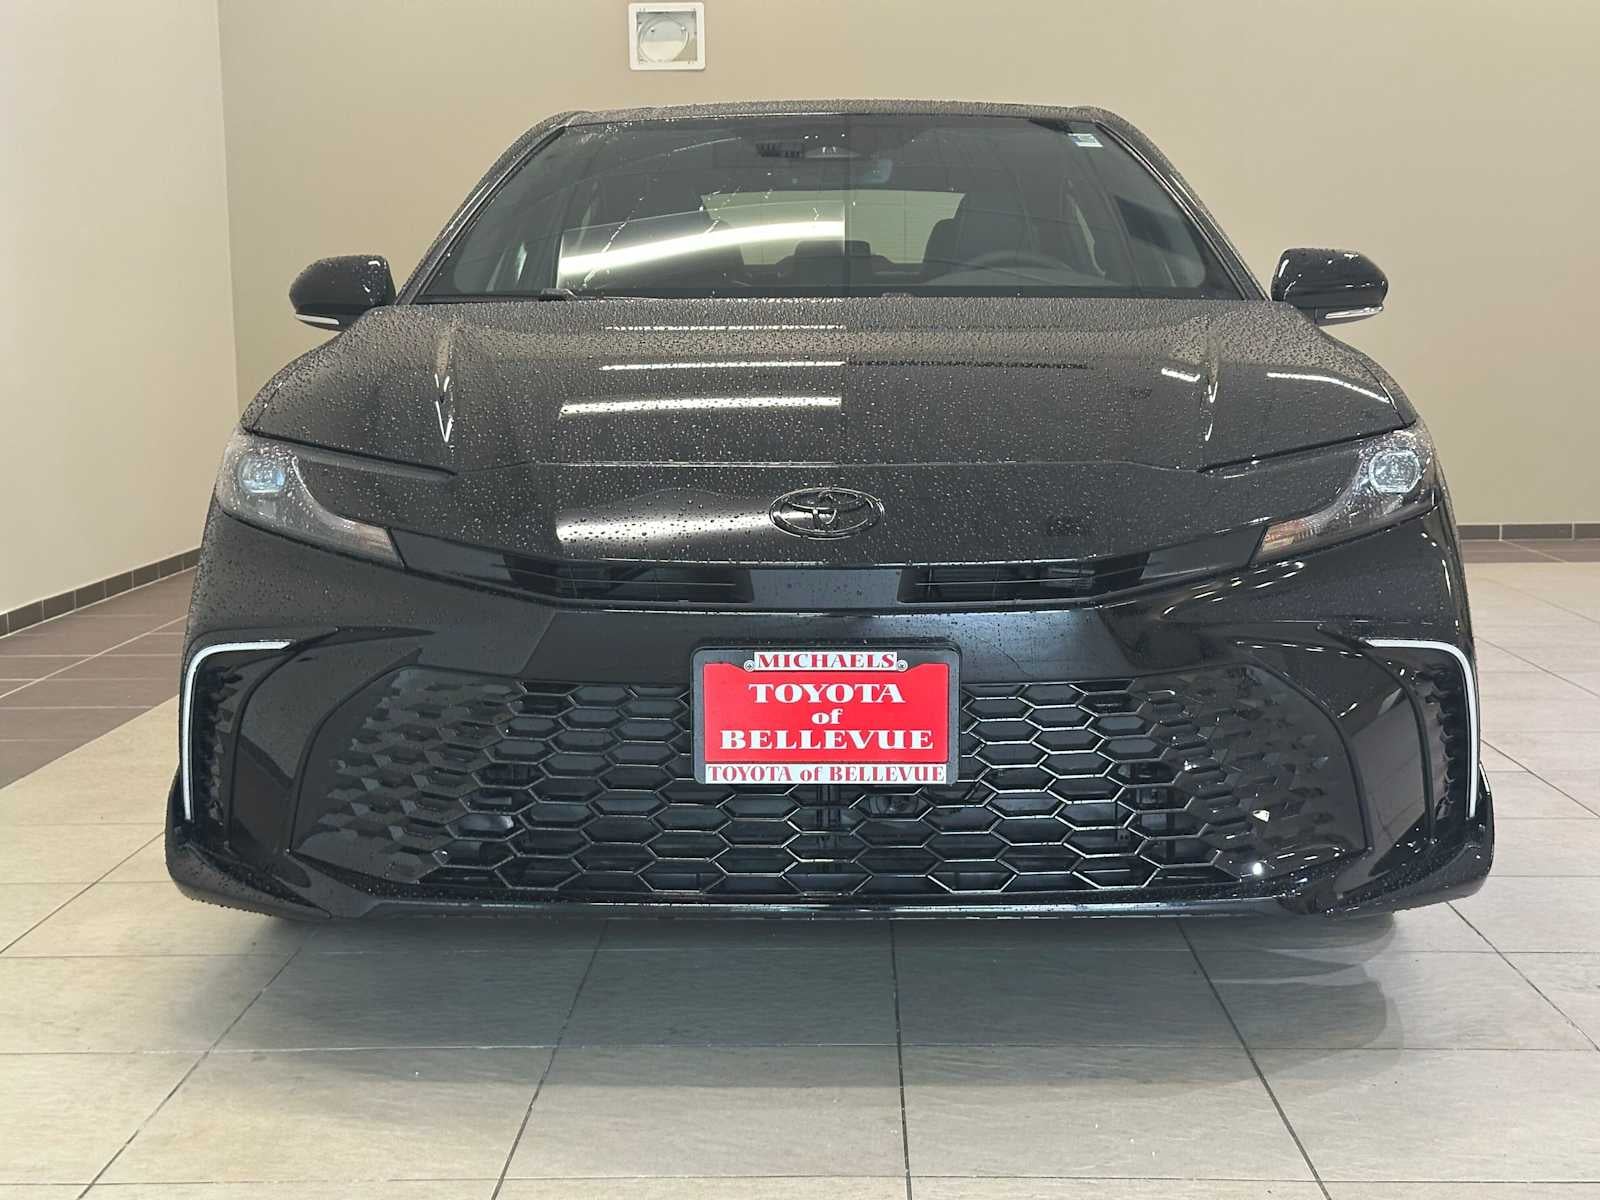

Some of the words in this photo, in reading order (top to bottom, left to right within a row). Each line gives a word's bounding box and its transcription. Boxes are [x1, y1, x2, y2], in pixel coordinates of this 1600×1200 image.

[757, 654, 895, 668] MICHAELS
[748, 683, 906, 703] TOYOTA
[811, 708, 843, 725] of
[720, 730, 934, 750] BELLEVUE
[708, 766, 793, 781] TOYOTA
[800, 766, 823, 781] of
[829, 766, 945, 781] BELLEVUE
